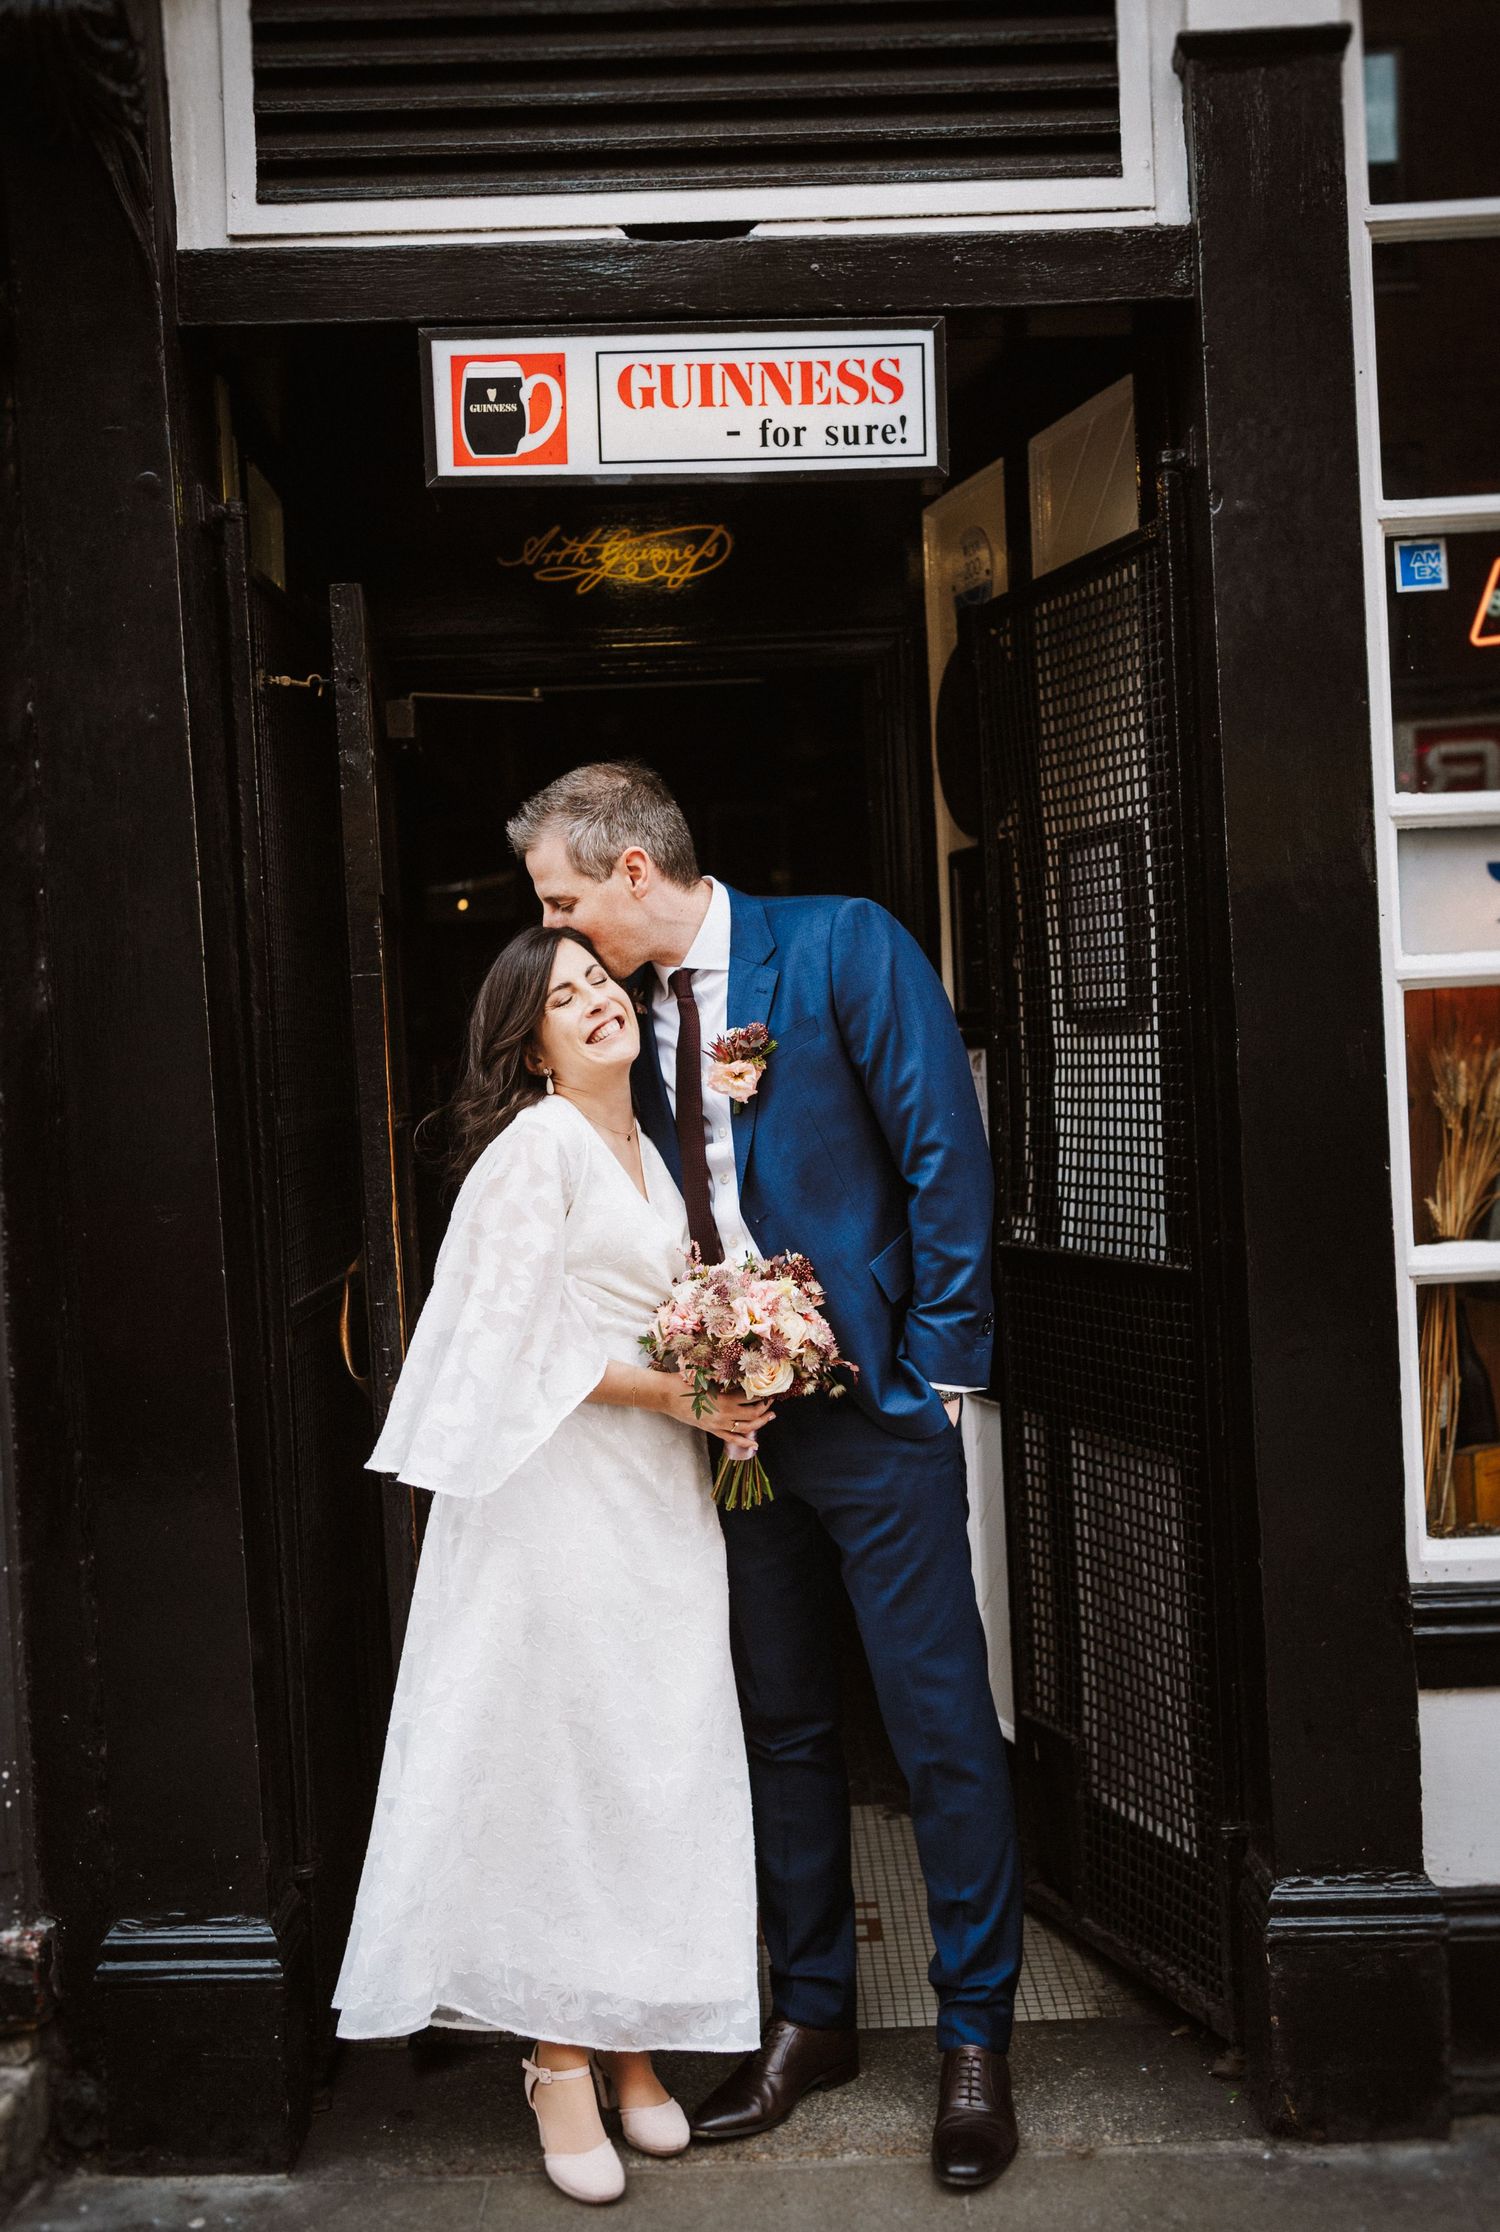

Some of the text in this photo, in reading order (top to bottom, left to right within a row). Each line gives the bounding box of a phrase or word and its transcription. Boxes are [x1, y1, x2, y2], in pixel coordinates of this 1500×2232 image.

[617, 358, 904, 410] GUINNESS
[469, 403, 518, 413] GUINNESS
[759, 418, 807, 448] for
[825, 415, 908, 446] sure!
